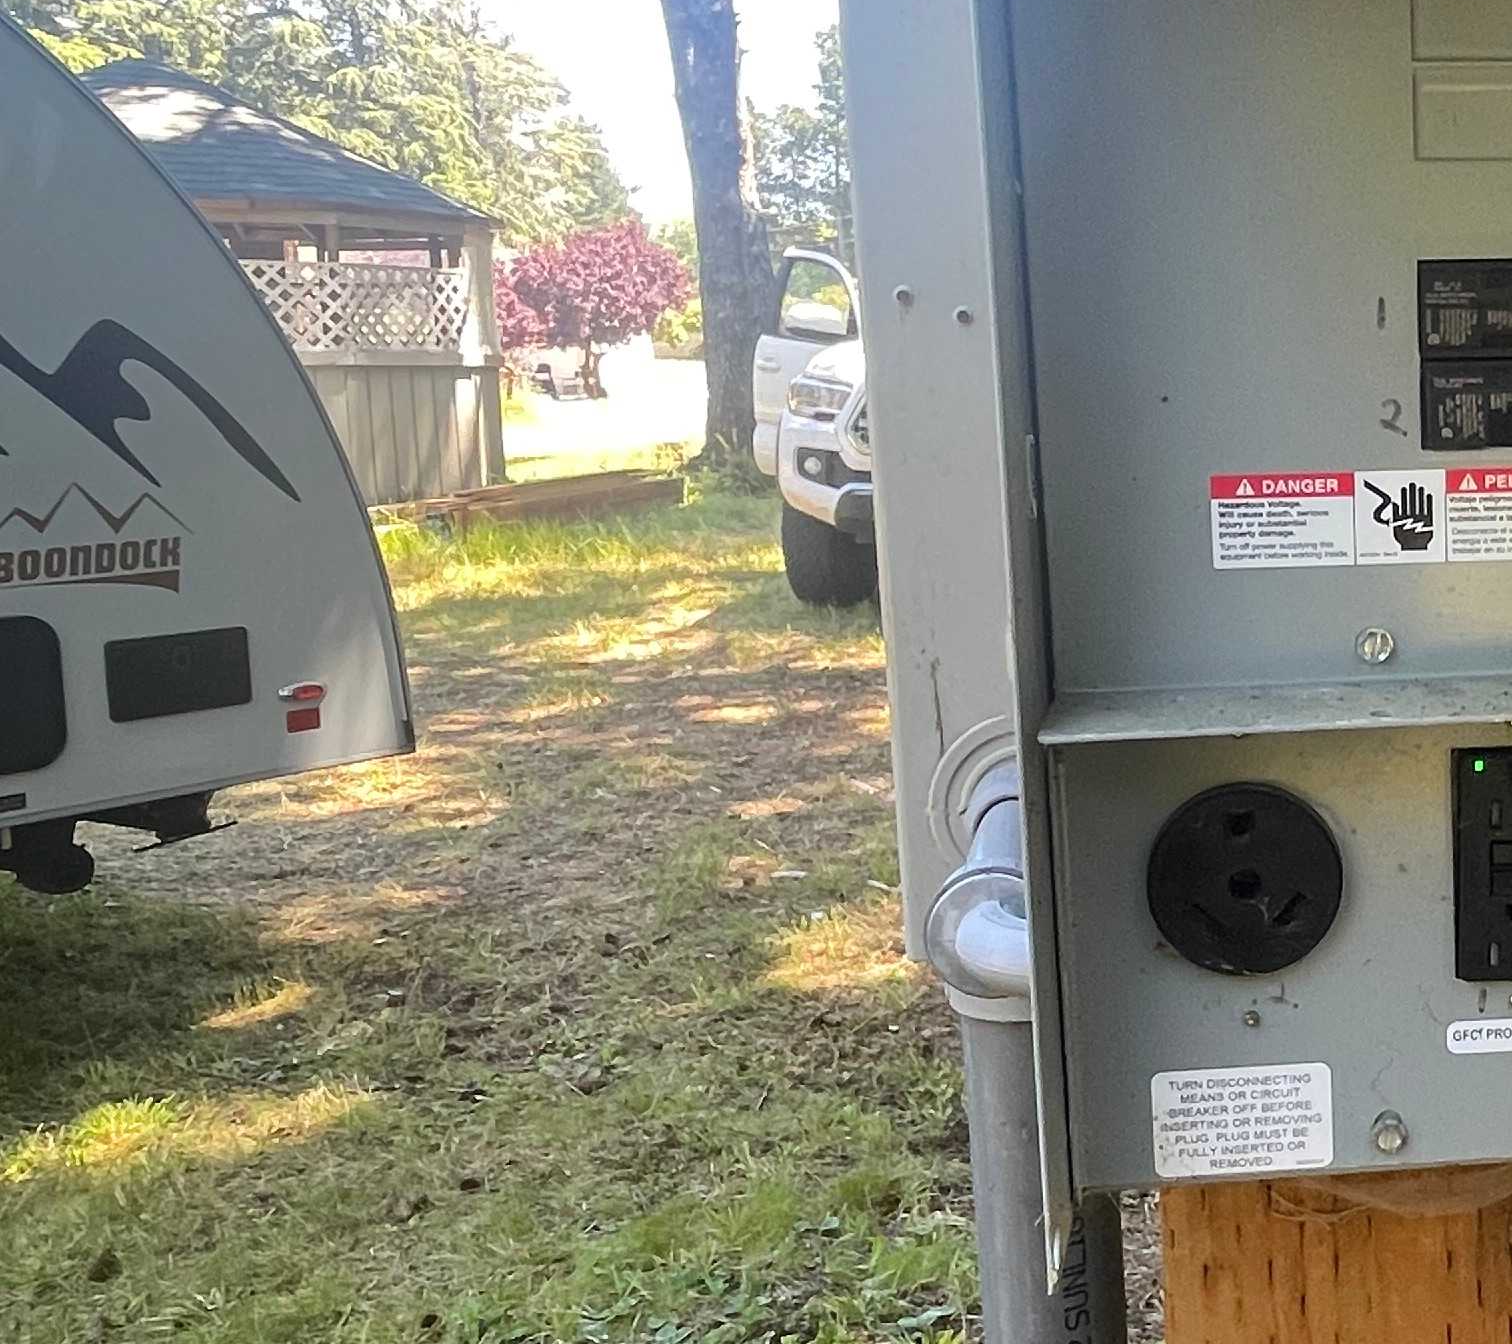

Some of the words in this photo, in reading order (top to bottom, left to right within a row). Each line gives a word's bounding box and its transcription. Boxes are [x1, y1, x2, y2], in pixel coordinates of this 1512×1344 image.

[1379, 398, 1408, 437] 2
[1262, 478, 1339, 494] DANGER
[1218, 521, 1242, 529] injury
[0, 536, 182, 584] BOONDOCK
[1169, 1080, 1203, 1091] TURN
[1207, 1073, 1311, 1089] DISCONNECTING
[1180, 1093, 1224, 1103] MEANS
[1228, 1091, 1247, 1101] OR
[1250, 1087, 1300, 1099] CIRCUIT
[1167, 1105, 1229, 1118] BREAKER
[1232, 1104, 1257, 1114] OFF
[1261, 1100, 1313, 1113] BEFORE
[1160, 1120, 1228, 1132] INSERTING
[1232, 1117, 1251, 1128] OR
[1254, 1113, 1322, 1126] REMOVING
[1216, 1131, 1250, 1142] PLUG
[1254, 1128, 1288, 1139] MUST
[1292, 1127, 1309, 1137] BE
[1178, 1146, 1218, 1157] FULLY
[1221, 1142, 1284, 1155] INSERTED
[1287, 1141, 1306, 1151] OR
[1210, 1156, 1273, 1169] REMOVED
